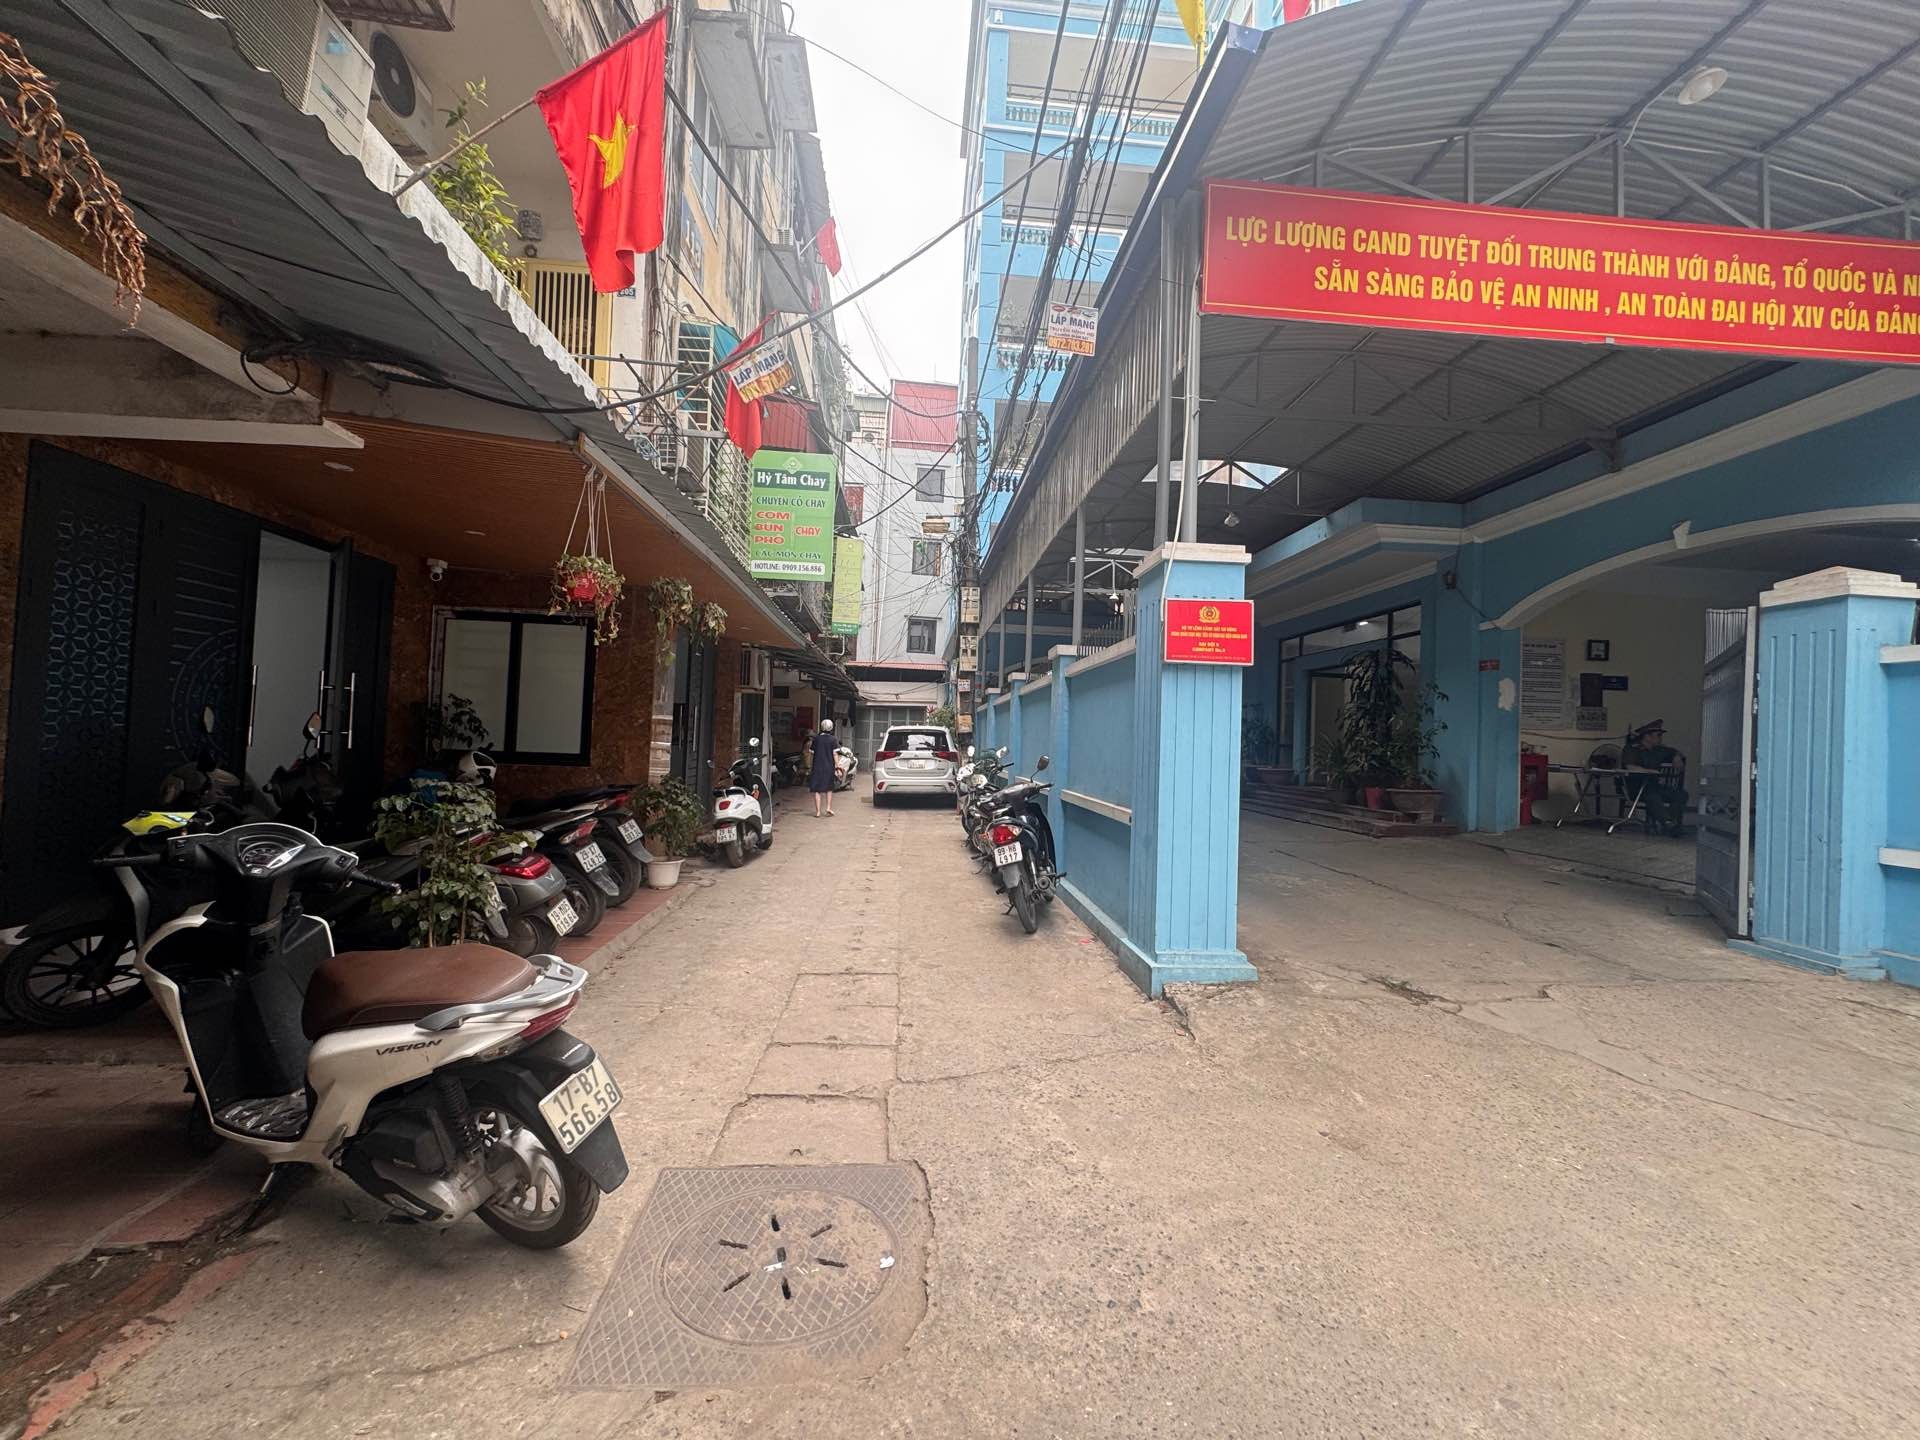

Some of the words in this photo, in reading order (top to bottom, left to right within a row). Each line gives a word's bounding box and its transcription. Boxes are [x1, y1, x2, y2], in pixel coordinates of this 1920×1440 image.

[1226, 215, 1267, 247] LỰC
[1275, 220, 1345, 253] LƯỢNG
[1353, 228, 1411, 256] CAND
[1418, 234, 1480, 267] TUYỆT
[1486, 235, 1521, 267] ĐỐI
[1528, 244, 1596, 273] TRUNG
[1602, 248, 1669, 279] THÀNH
[1676, 254, 1708, 282] VỚI
[1714, 254, 1776, 290] ĐẢNG,
[1783, 258, 1808, 289] TỔ
[1813, 262, 1866, 294] QUỐC
[1872, 267, 1898, 295] VÀ
[1903, 274, 1920, 297] N
[1314, 259, 1359, 293] SẴN
[1366, 268, 1424, 299] SÀNG
[1431, 270, 1473, 303] BẢO
[1480, 277, 1505, 310] VỆ
[1511, 283, 1541, 308] AN
[1547, 286, 1599, 313] NINH
[1617, 291, 1646, 316] AN
[1652, 292, 1706, 321] TOÀN
[1711, 298, 1745, 328] ĐẠI
[1752, 299, 1785, 330] HỘI
[1791, 305, 1824, 330] XIV
[1830, 301, 1870, 332] CỦA
[1876, 304, 1920, 335] ĐẢN
[757, 471, 772, 486] Hỷ
[775, 472, 797, 485] Tâm
[800, 474, 827, 489] Chay
[805, 499, 826, 508] CHAY
[795, 526, 821, 536] CHAY
[376, 1039, 443, 1056] VISION
[553, 1065, 599, 1116] 17-B7
[558, 1082, 618, 1146] 566.58
